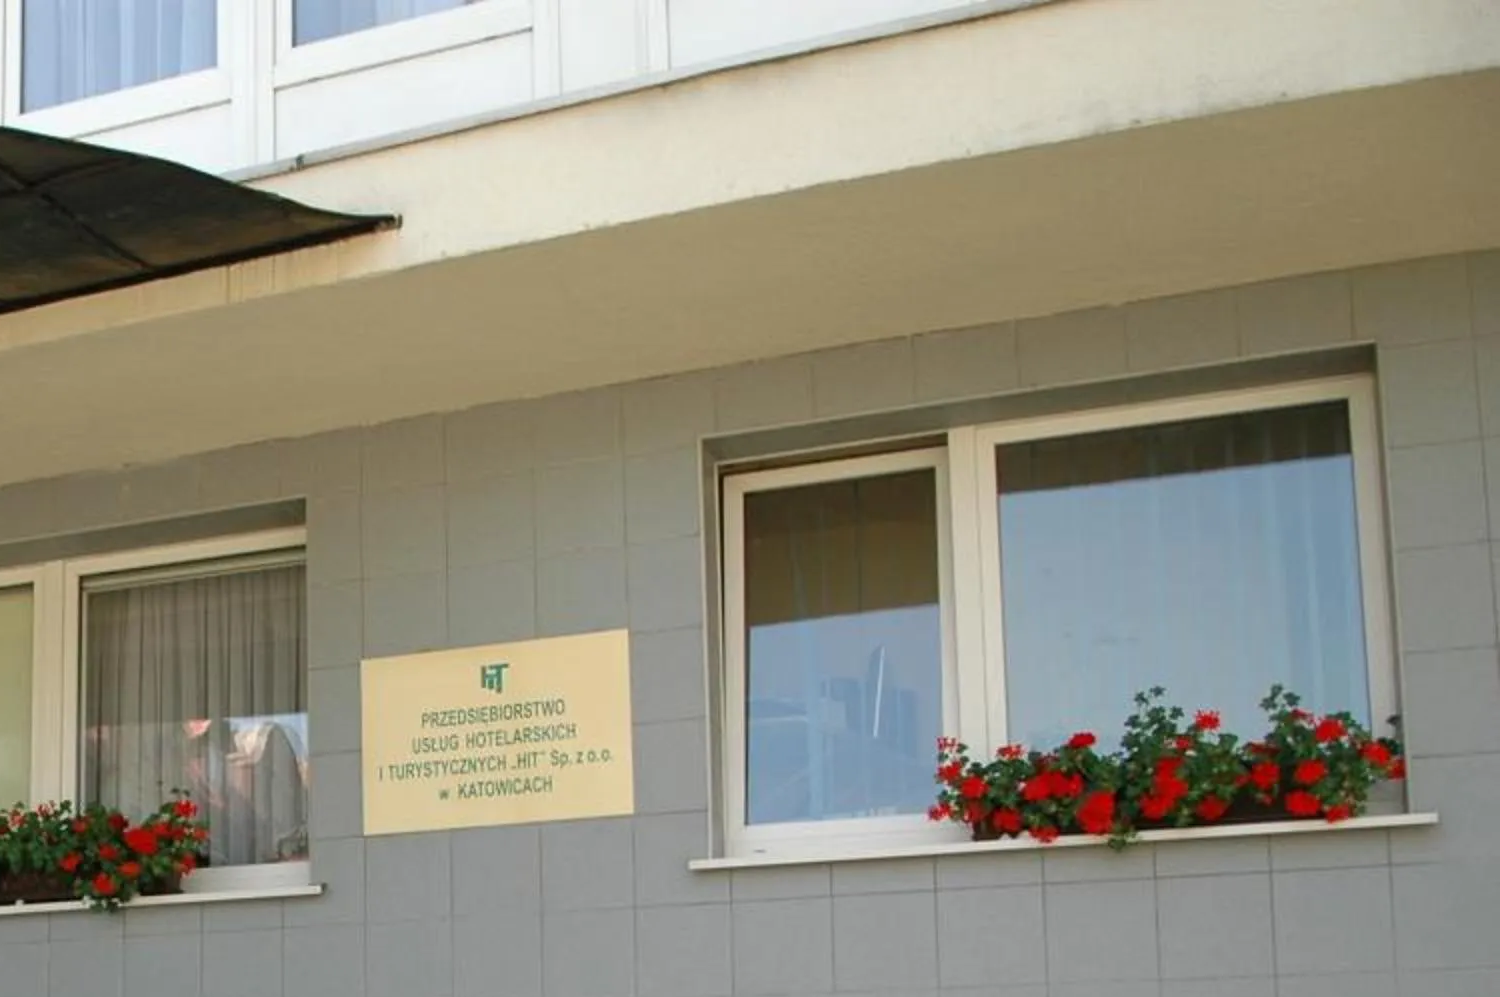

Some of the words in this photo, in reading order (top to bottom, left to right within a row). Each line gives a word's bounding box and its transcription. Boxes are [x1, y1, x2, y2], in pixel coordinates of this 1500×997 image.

[412, 734, 460, 755] USŁUG
[465, 723, 577, 749] HOTELARSKICH
[388, 754, 507, 781] TURYSTYCZNYCH
[550, 749, 574, 769] Sp.
[457, 776, 553, 799] KATOWICACH
